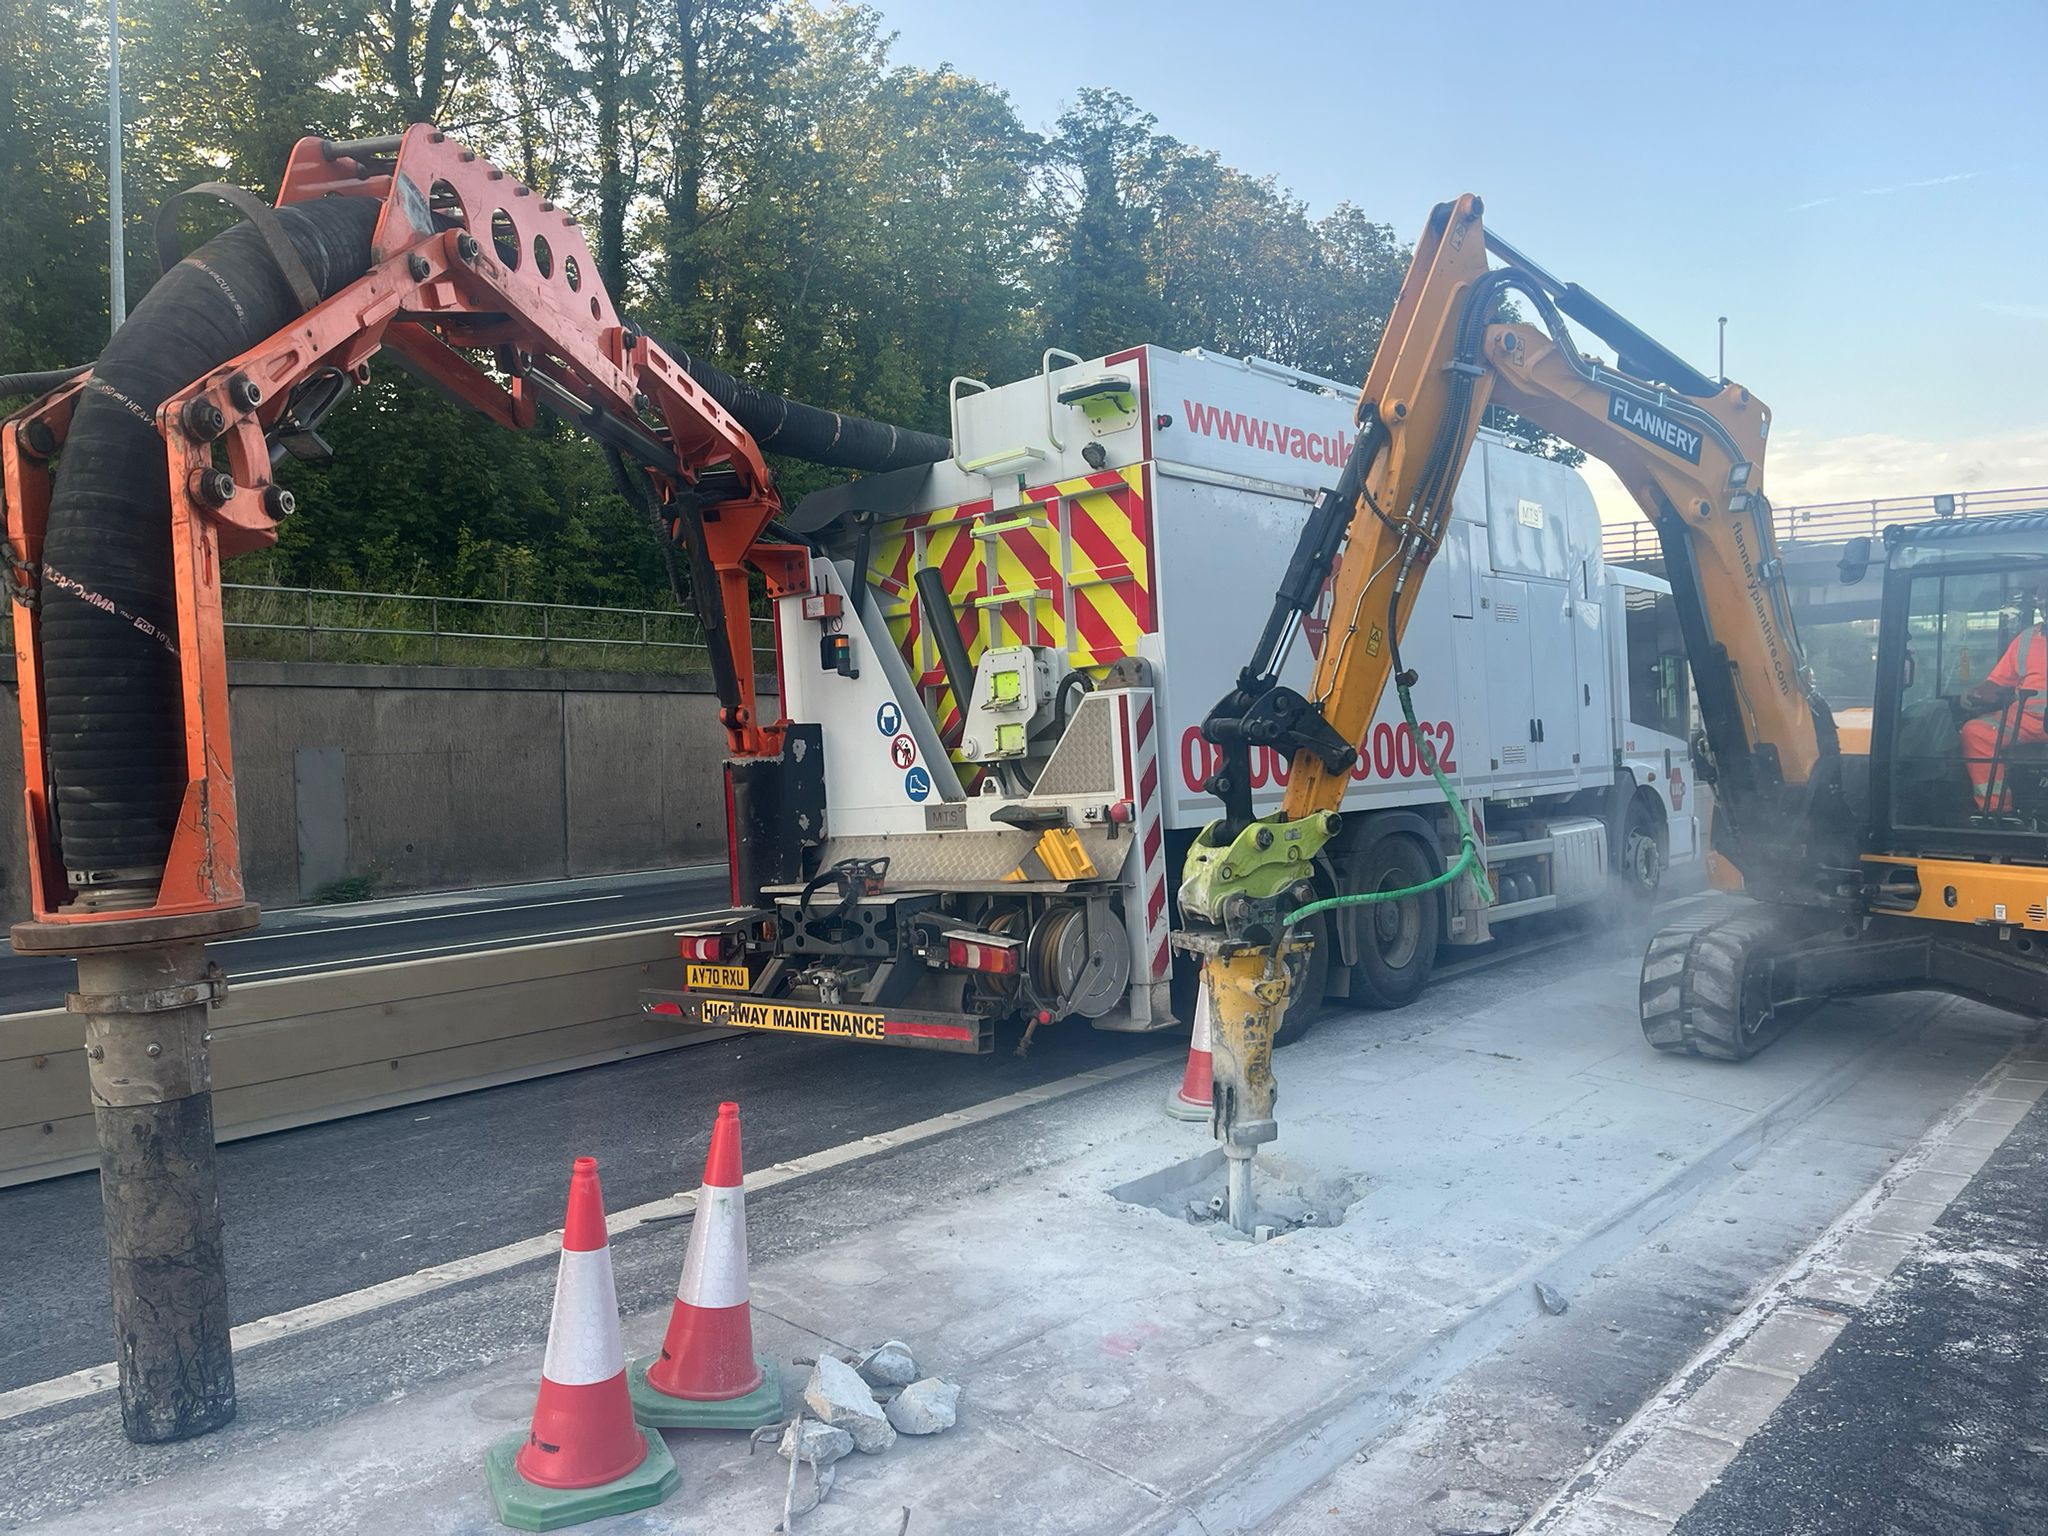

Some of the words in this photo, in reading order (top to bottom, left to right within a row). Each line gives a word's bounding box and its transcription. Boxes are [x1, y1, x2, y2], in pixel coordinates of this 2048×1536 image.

[125, 399, 157, 427] HEAVY
[1613, 396, 1698, 455] FLANNERY
[1183, 399, 1359, 469] www.vacuk
[1732, 521, 1790, 696] flanneryplanthire.com
[932, 810, 958, 823] MTS
[692, 967, 720, 985] AY70
[722, 968, 744, 987] RXU
[773, 1009, 885, 1036] MAINTENANCE
